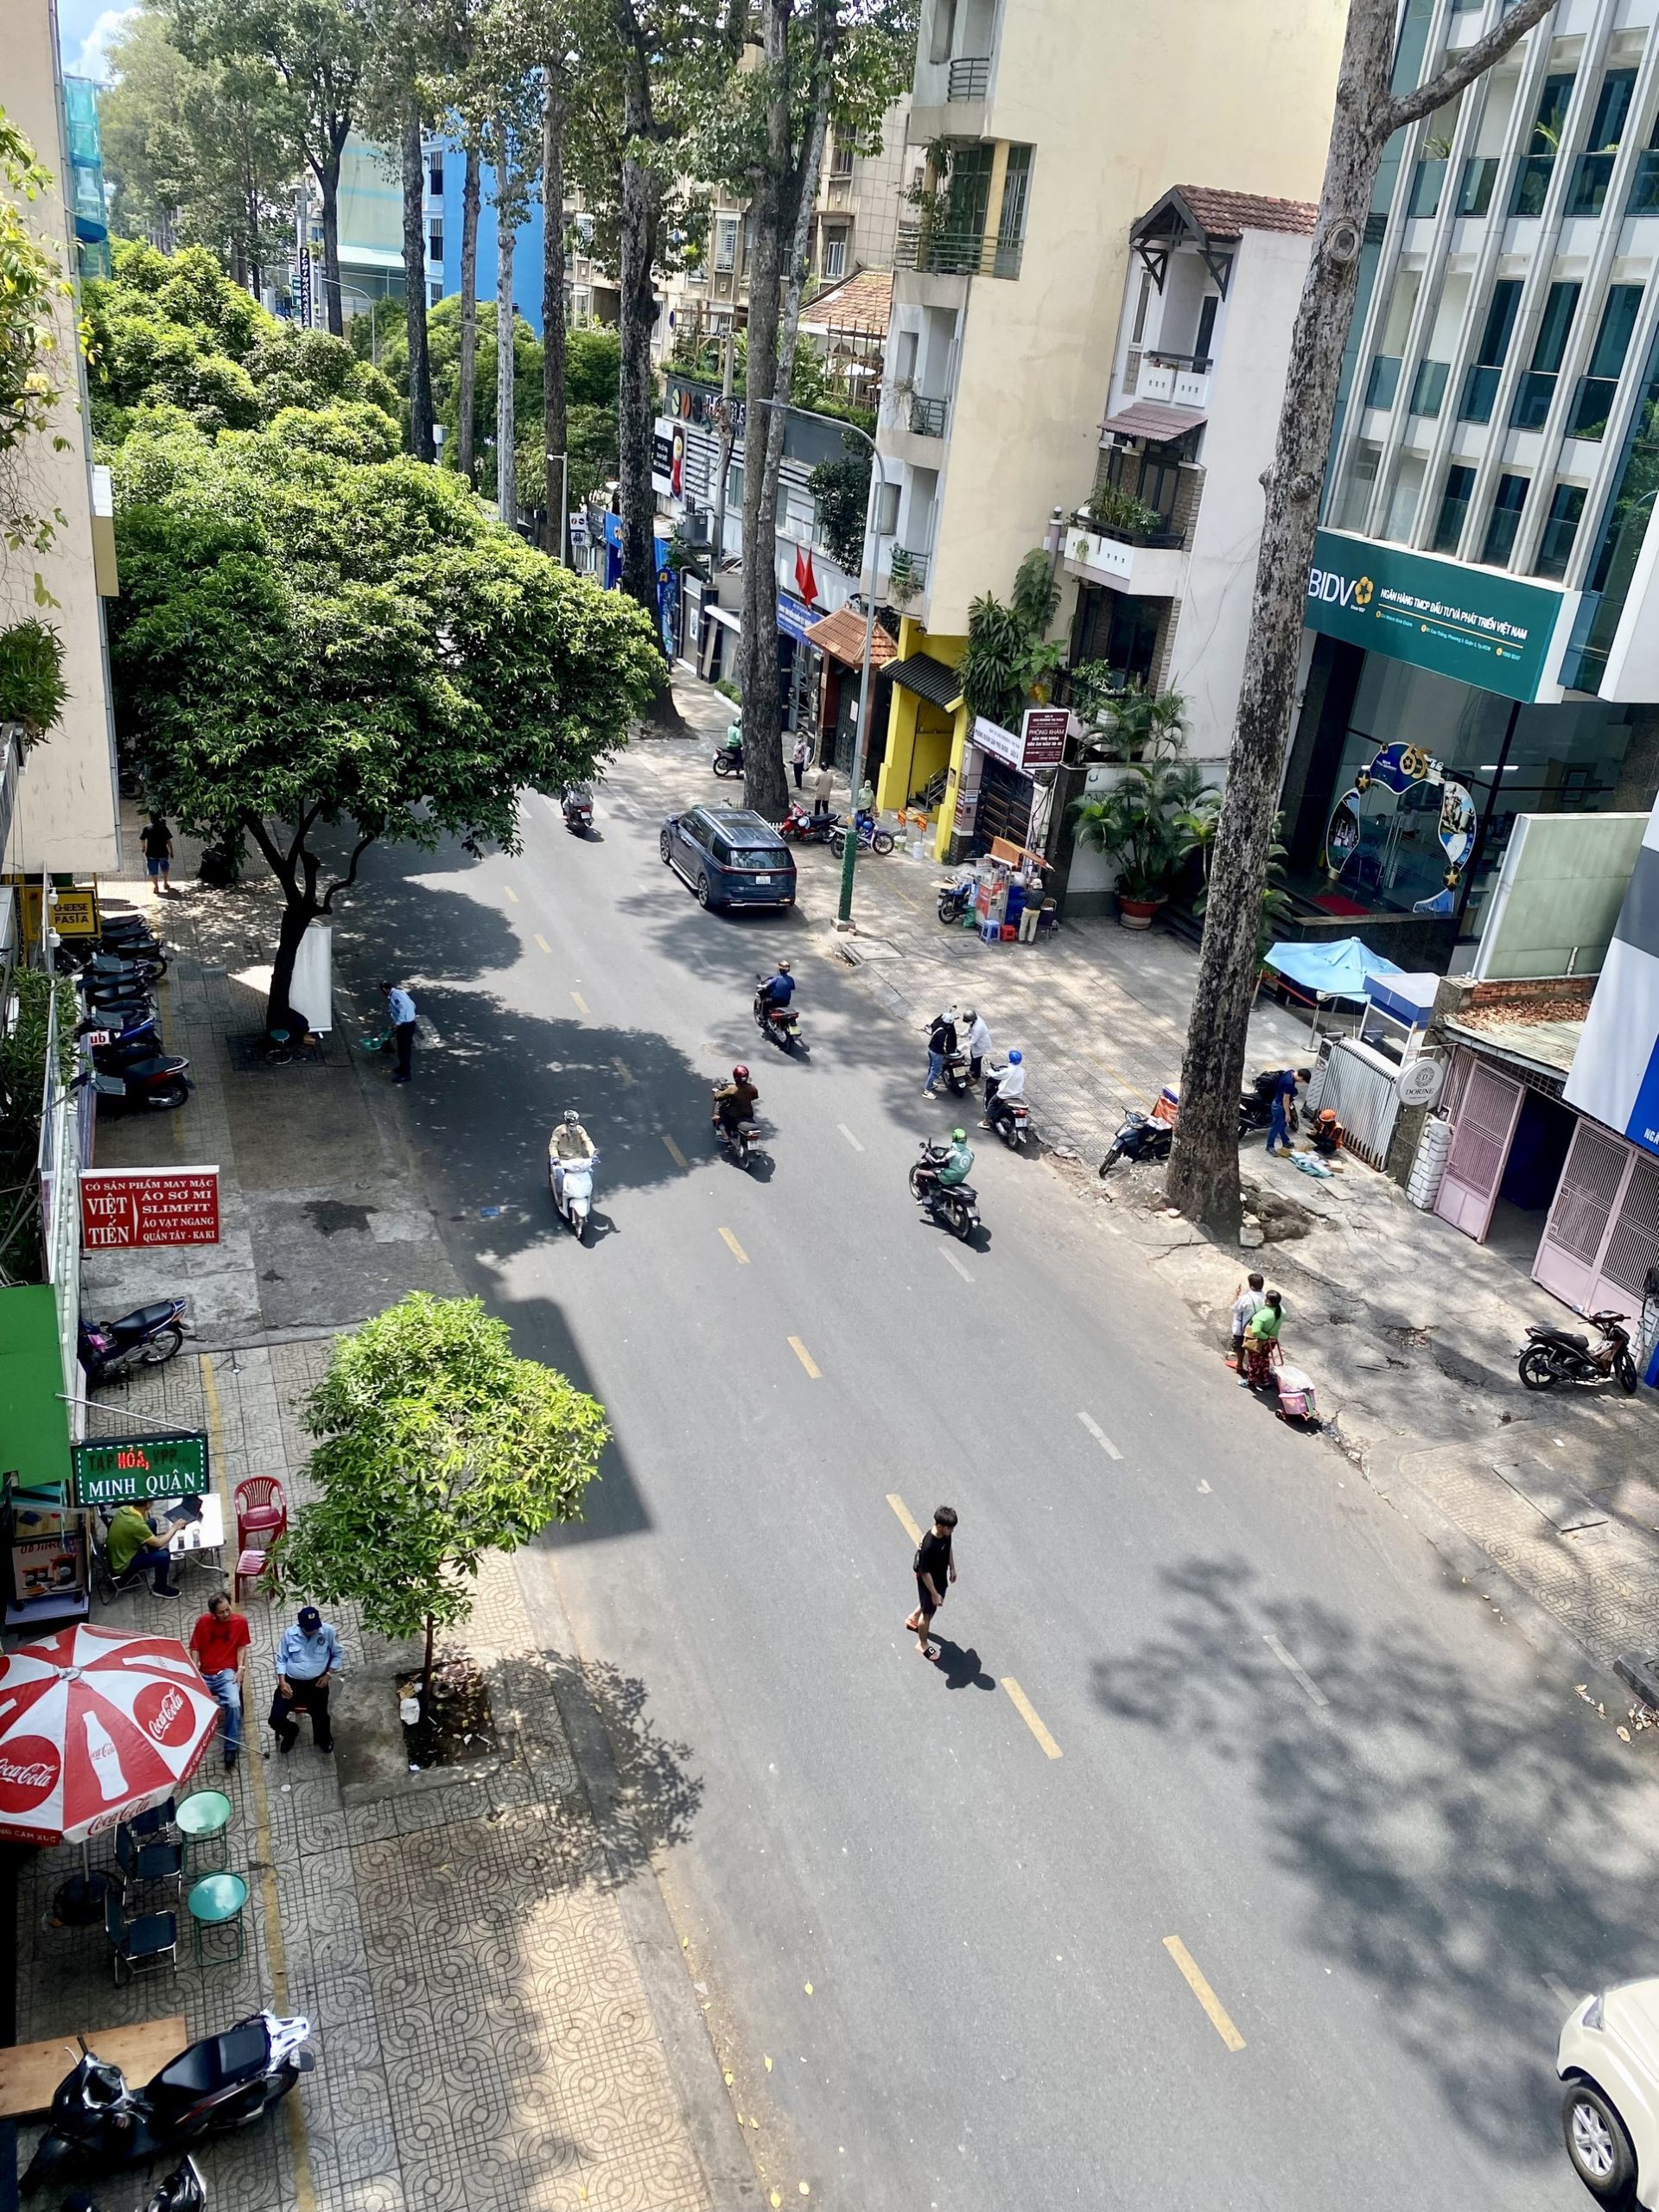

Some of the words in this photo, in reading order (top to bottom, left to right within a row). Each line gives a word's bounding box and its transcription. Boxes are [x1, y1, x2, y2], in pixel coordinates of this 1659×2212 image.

[1307, 567, 1357, 607] BIDV
[1380, 588, 1398, 602] NGÂN
[1396, 592, 1414, 607] HÀNG
[1414, 597, 1431, 611] TMCP
[1452, 607, 1461, 621] VÀ
[1460, 611, 1478, 625] PHÁT
[1497, 621, 1512, 636] VIỆT
[1510, 626, 1529, 640] NAM
[54, 903, 89, 912] CHEESE
[54, 913, 89, 925] PASTA
[85, 1182, 101, 1192] CÓ
[104, 1180, 126, 1191] SẢN
[163, 1180, 187, 1189] MAY
[189, 1179, 213, 1189] MẶC
[141, 1191, 164, 1201] ÁO
[168, 1190, 189, 1200] SƠ
[193, 1190, 212, 1199] MI
[86, 1192, 128, 1219] VIỆT
[142, 1203, 211, 1214] SLIMFIT
[143, 1217, 157, 1228] ÁO
[158, 1218, 179, 1229] VẠT
[180, 1217, 214, 1226] NGANG
[88, 1218, 130, 1245] TIẾN
[168, 1230, 187, 1240] TÂY
[89, 1478, 137, 1497] MINH
[145, 1468, 195, 1495] QUÂN
